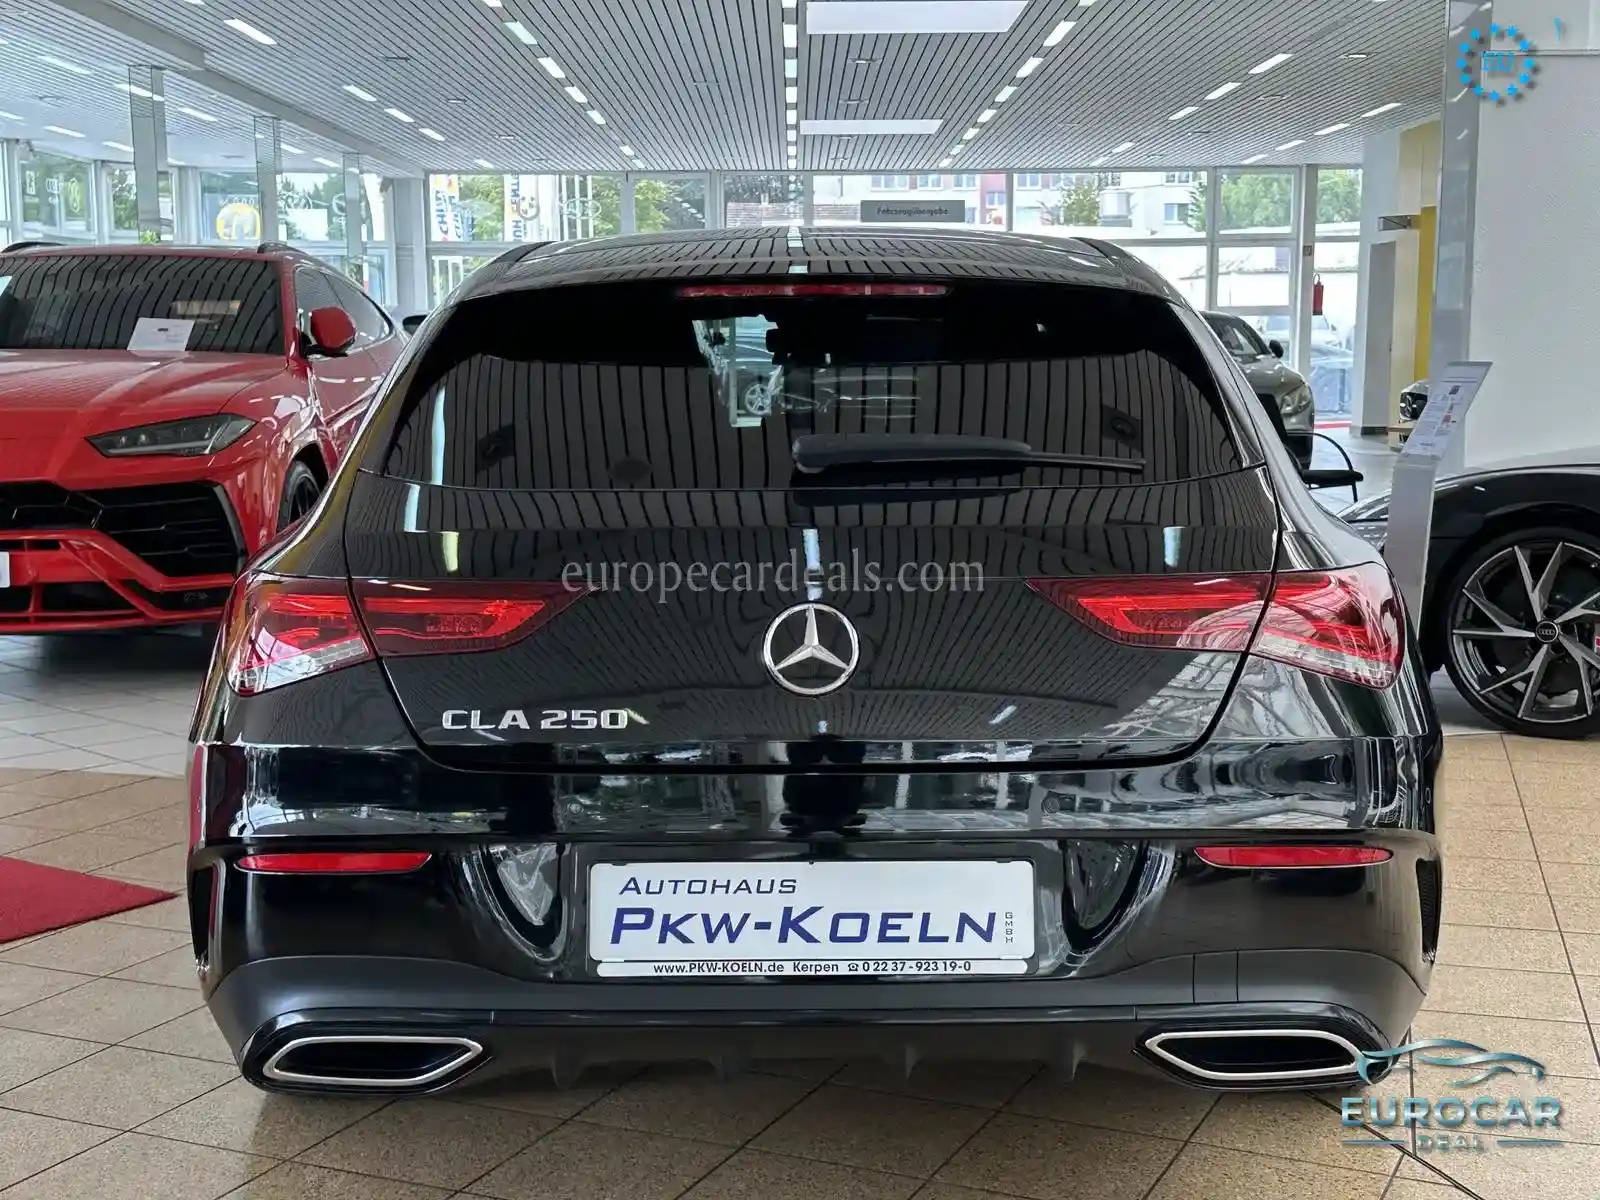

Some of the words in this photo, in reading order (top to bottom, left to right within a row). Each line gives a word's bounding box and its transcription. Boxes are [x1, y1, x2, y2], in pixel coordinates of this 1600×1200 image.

[442, 709, 531, 730] CLA
[540, 709, 629, 730] 250
[618, 876, 798, 895] AUTOHAUS
[610, 905, 997, 944] PKW-KOELN
[1004, 911, 1015, 945] GMBH
[653, 961, 785, 974] www.PKW-KOELN.de
[793, 961, 839, 976] Kerpen
